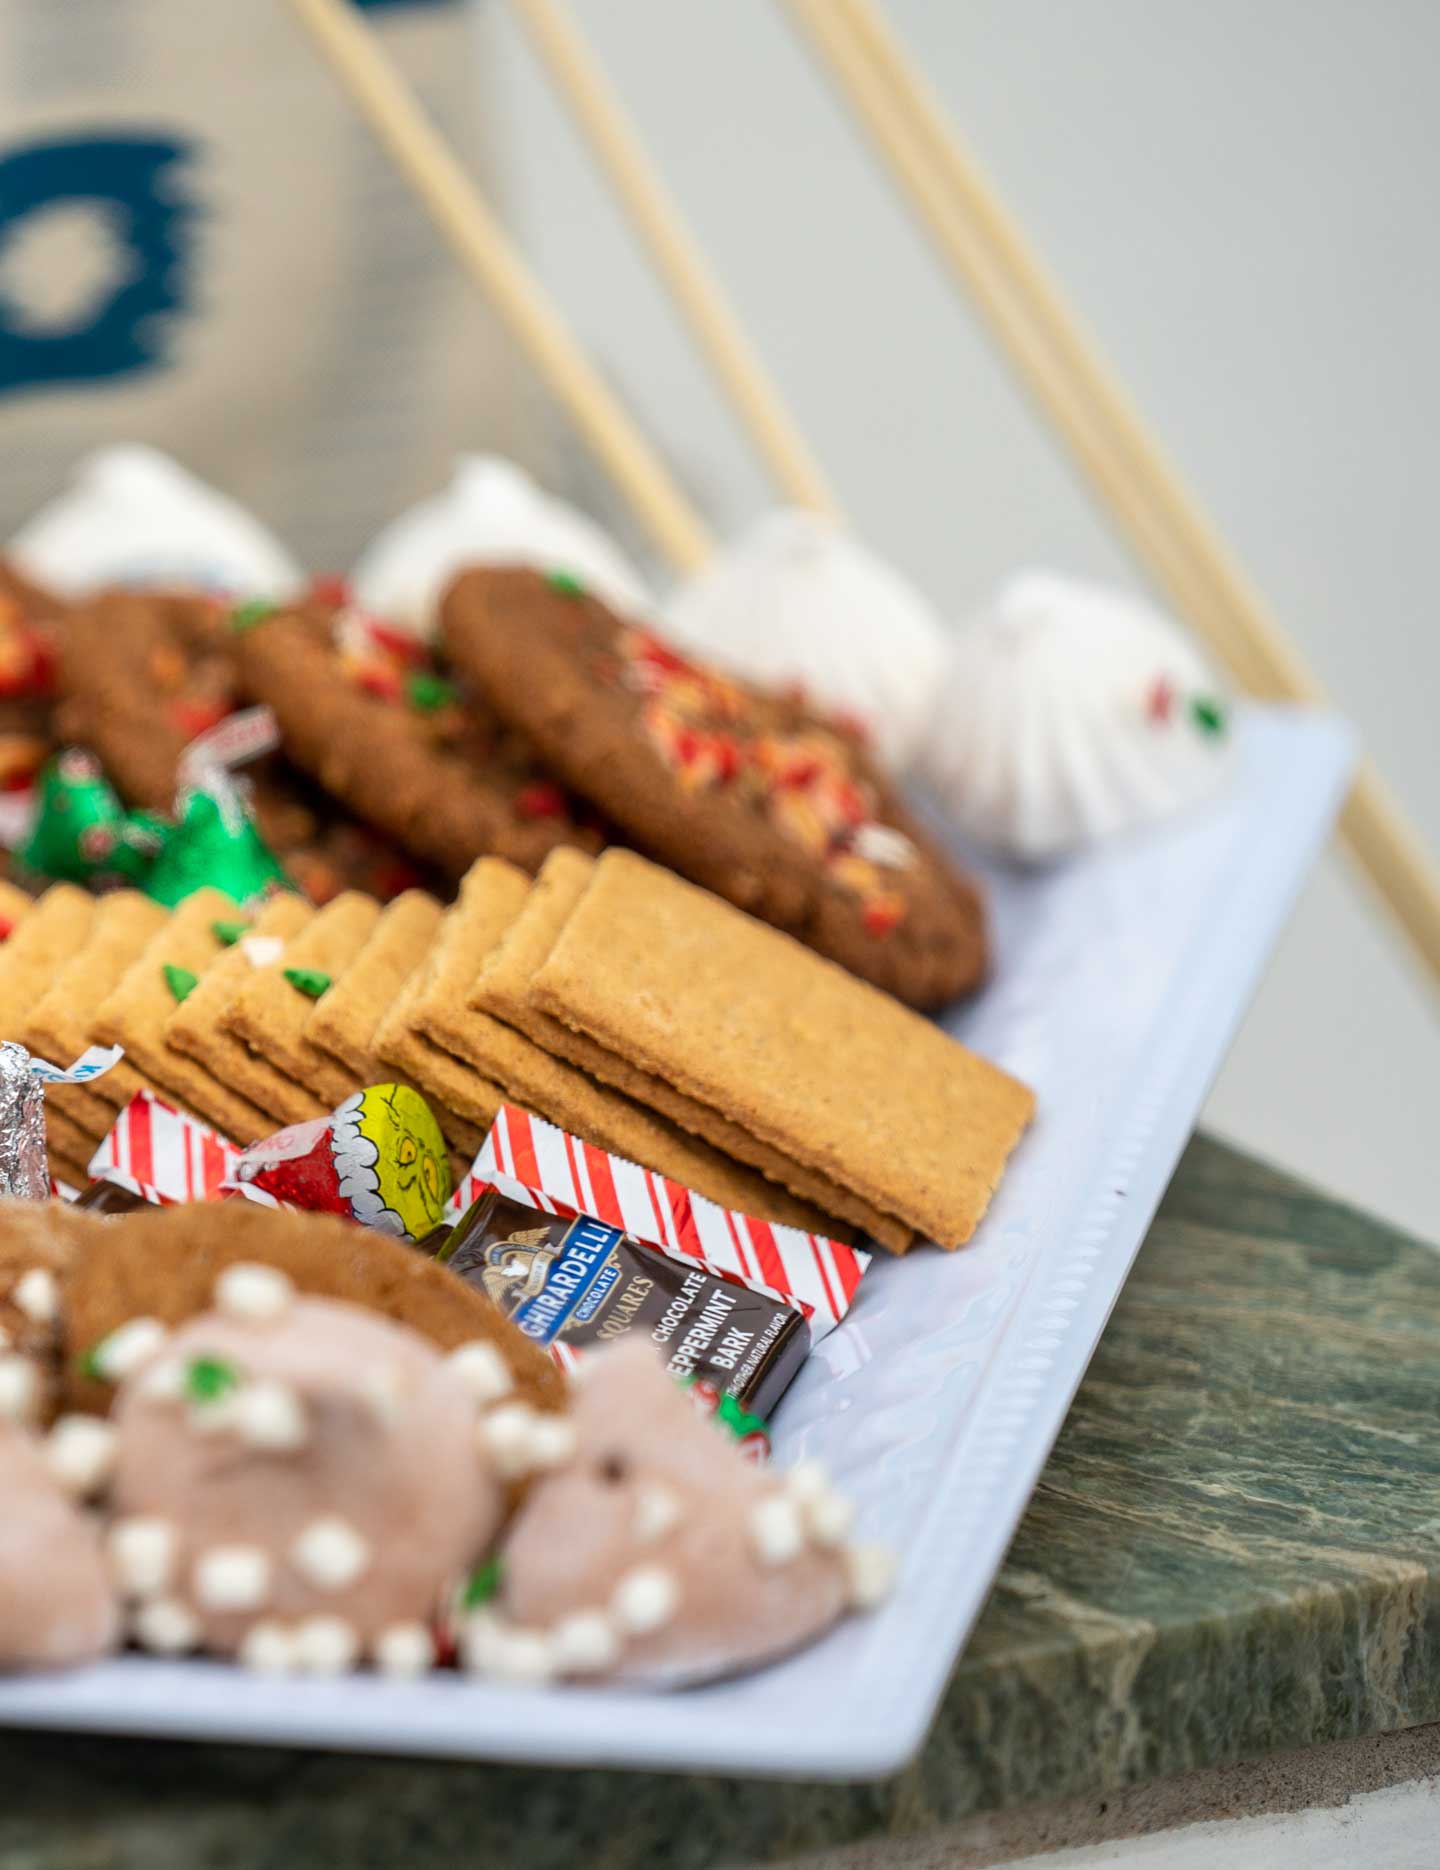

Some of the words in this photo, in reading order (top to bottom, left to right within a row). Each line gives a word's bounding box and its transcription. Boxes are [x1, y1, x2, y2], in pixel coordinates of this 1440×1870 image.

[518, 1223, 613, 1337] GHIRARDELLI
[575, 1267, 617, 1319] CHOCOLATE
[596, 1277, 655, 1339] SQUARES
[651, 1272, 708, 1342] CHOCOLATE
[667, 1289, 736, 1376] EPPERMINT
[709, 1327, 755, 1370] BARK
[732, 1363, 755, 1386] OTHER
[746, 1335, 773, 1366] NATURAL
[764, 1312, 788, 1338] FLAVOR
